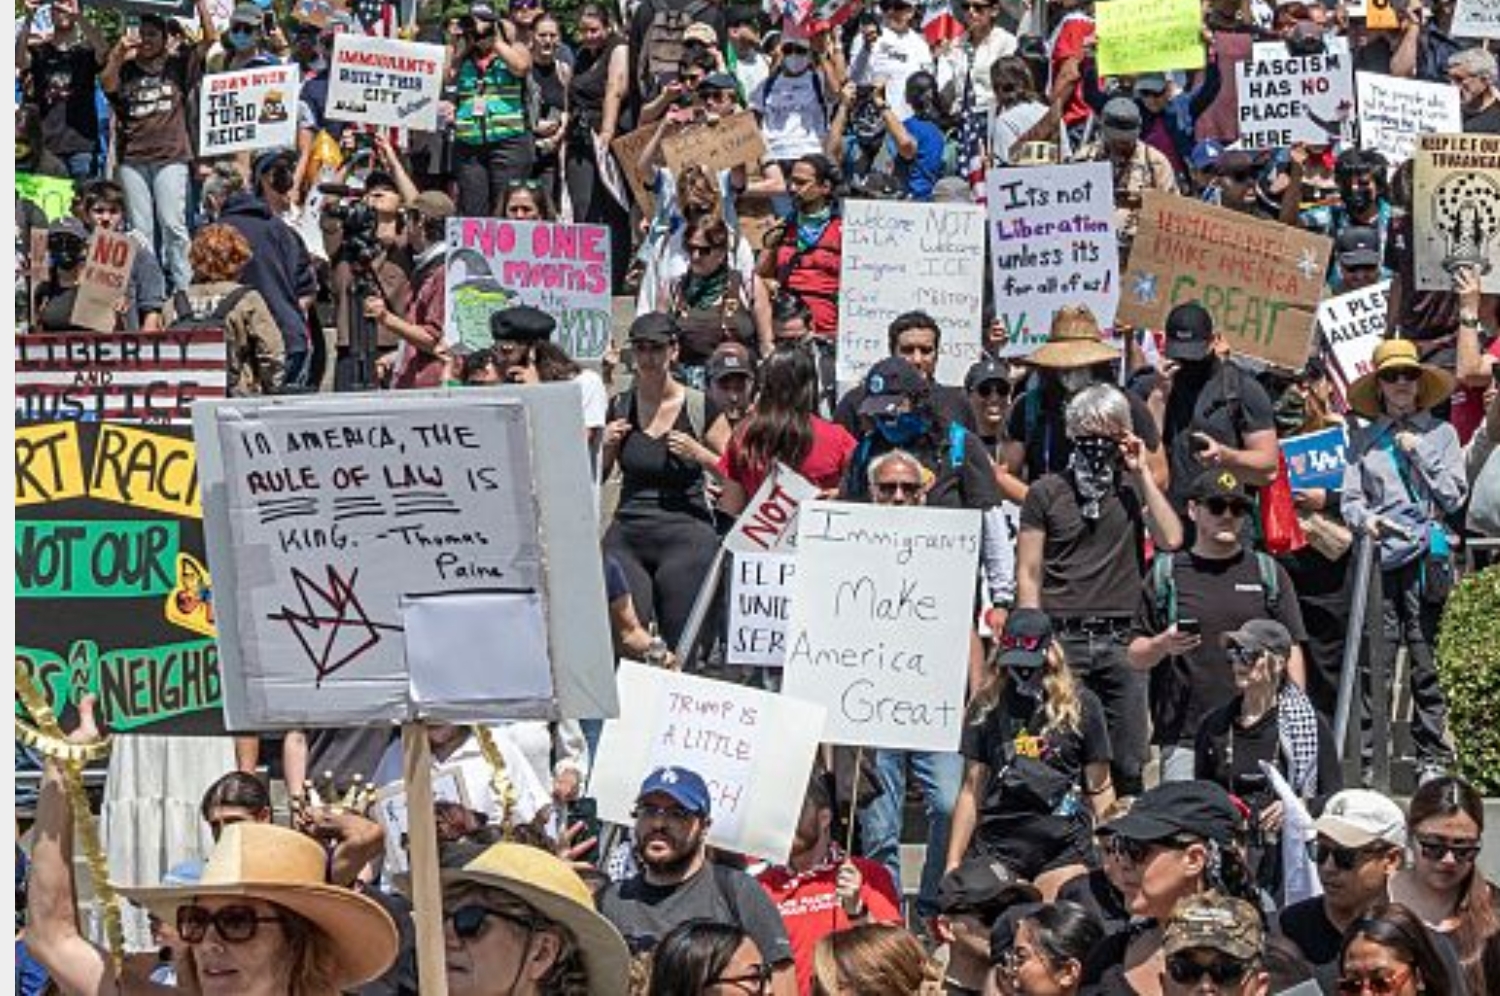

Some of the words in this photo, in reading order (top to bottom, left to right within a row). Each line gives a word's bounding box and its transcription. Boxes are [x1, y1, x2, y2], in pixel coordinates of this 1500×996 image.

[1243, 54, 1341, 77] FASCISM
[209, 91, 238, 107] THE
[363, 88, 401, 104] CITY
[1250, 81, 1291, 98] HAS
[1301, 77, 1329, 95] NO
[207, 103, 256, 127] TURD
[1241, 101, 1300, 121] PLACE
[1241, 129, 1291, 148] HERE
[1057, 181, 1093, 203] not
[926, 208, 977, 236] NOT
[996, 214, 1108, 240] Liberation
[95, 237, 129, 268] NO
[462, 219, 516, 258] NO
[532, 225, 606, 261] ONE
[1154, 237, 1209, 270] MAKE
[999, 244, 1063, 269] unless
[1003, 277, 1032, 296] for
[1037, 277, 1057, 293] all
[1061, 272, 1081, 292] of
[17, 334, 194, 367] LIBERTY
[75, 371, 113, 385] AND
[15, 381, 199, 419] JUSTICE
[410, 424, 480, 448] THE
[247, 465, 320, 494] RULE
[333, 465, 369, 489] OF
[383, 464, 443, 488] LAW
[468, 467, 499, 491] IS
[804, 508, 977, 565] Immigrants
[92, 526, 176, 591] OUR
[435, 552, 504, 579] Paine
[836, 576, 938, 621] Make
[789, 631, 925, 675] America
[669, 692, 735, 719] TRUMP
[739, 708, 758, 725] IS
[841, 678, 956, 726] Great
[663, 725, 676, 745] A
[684, 727, 751, 760] LITTLE
